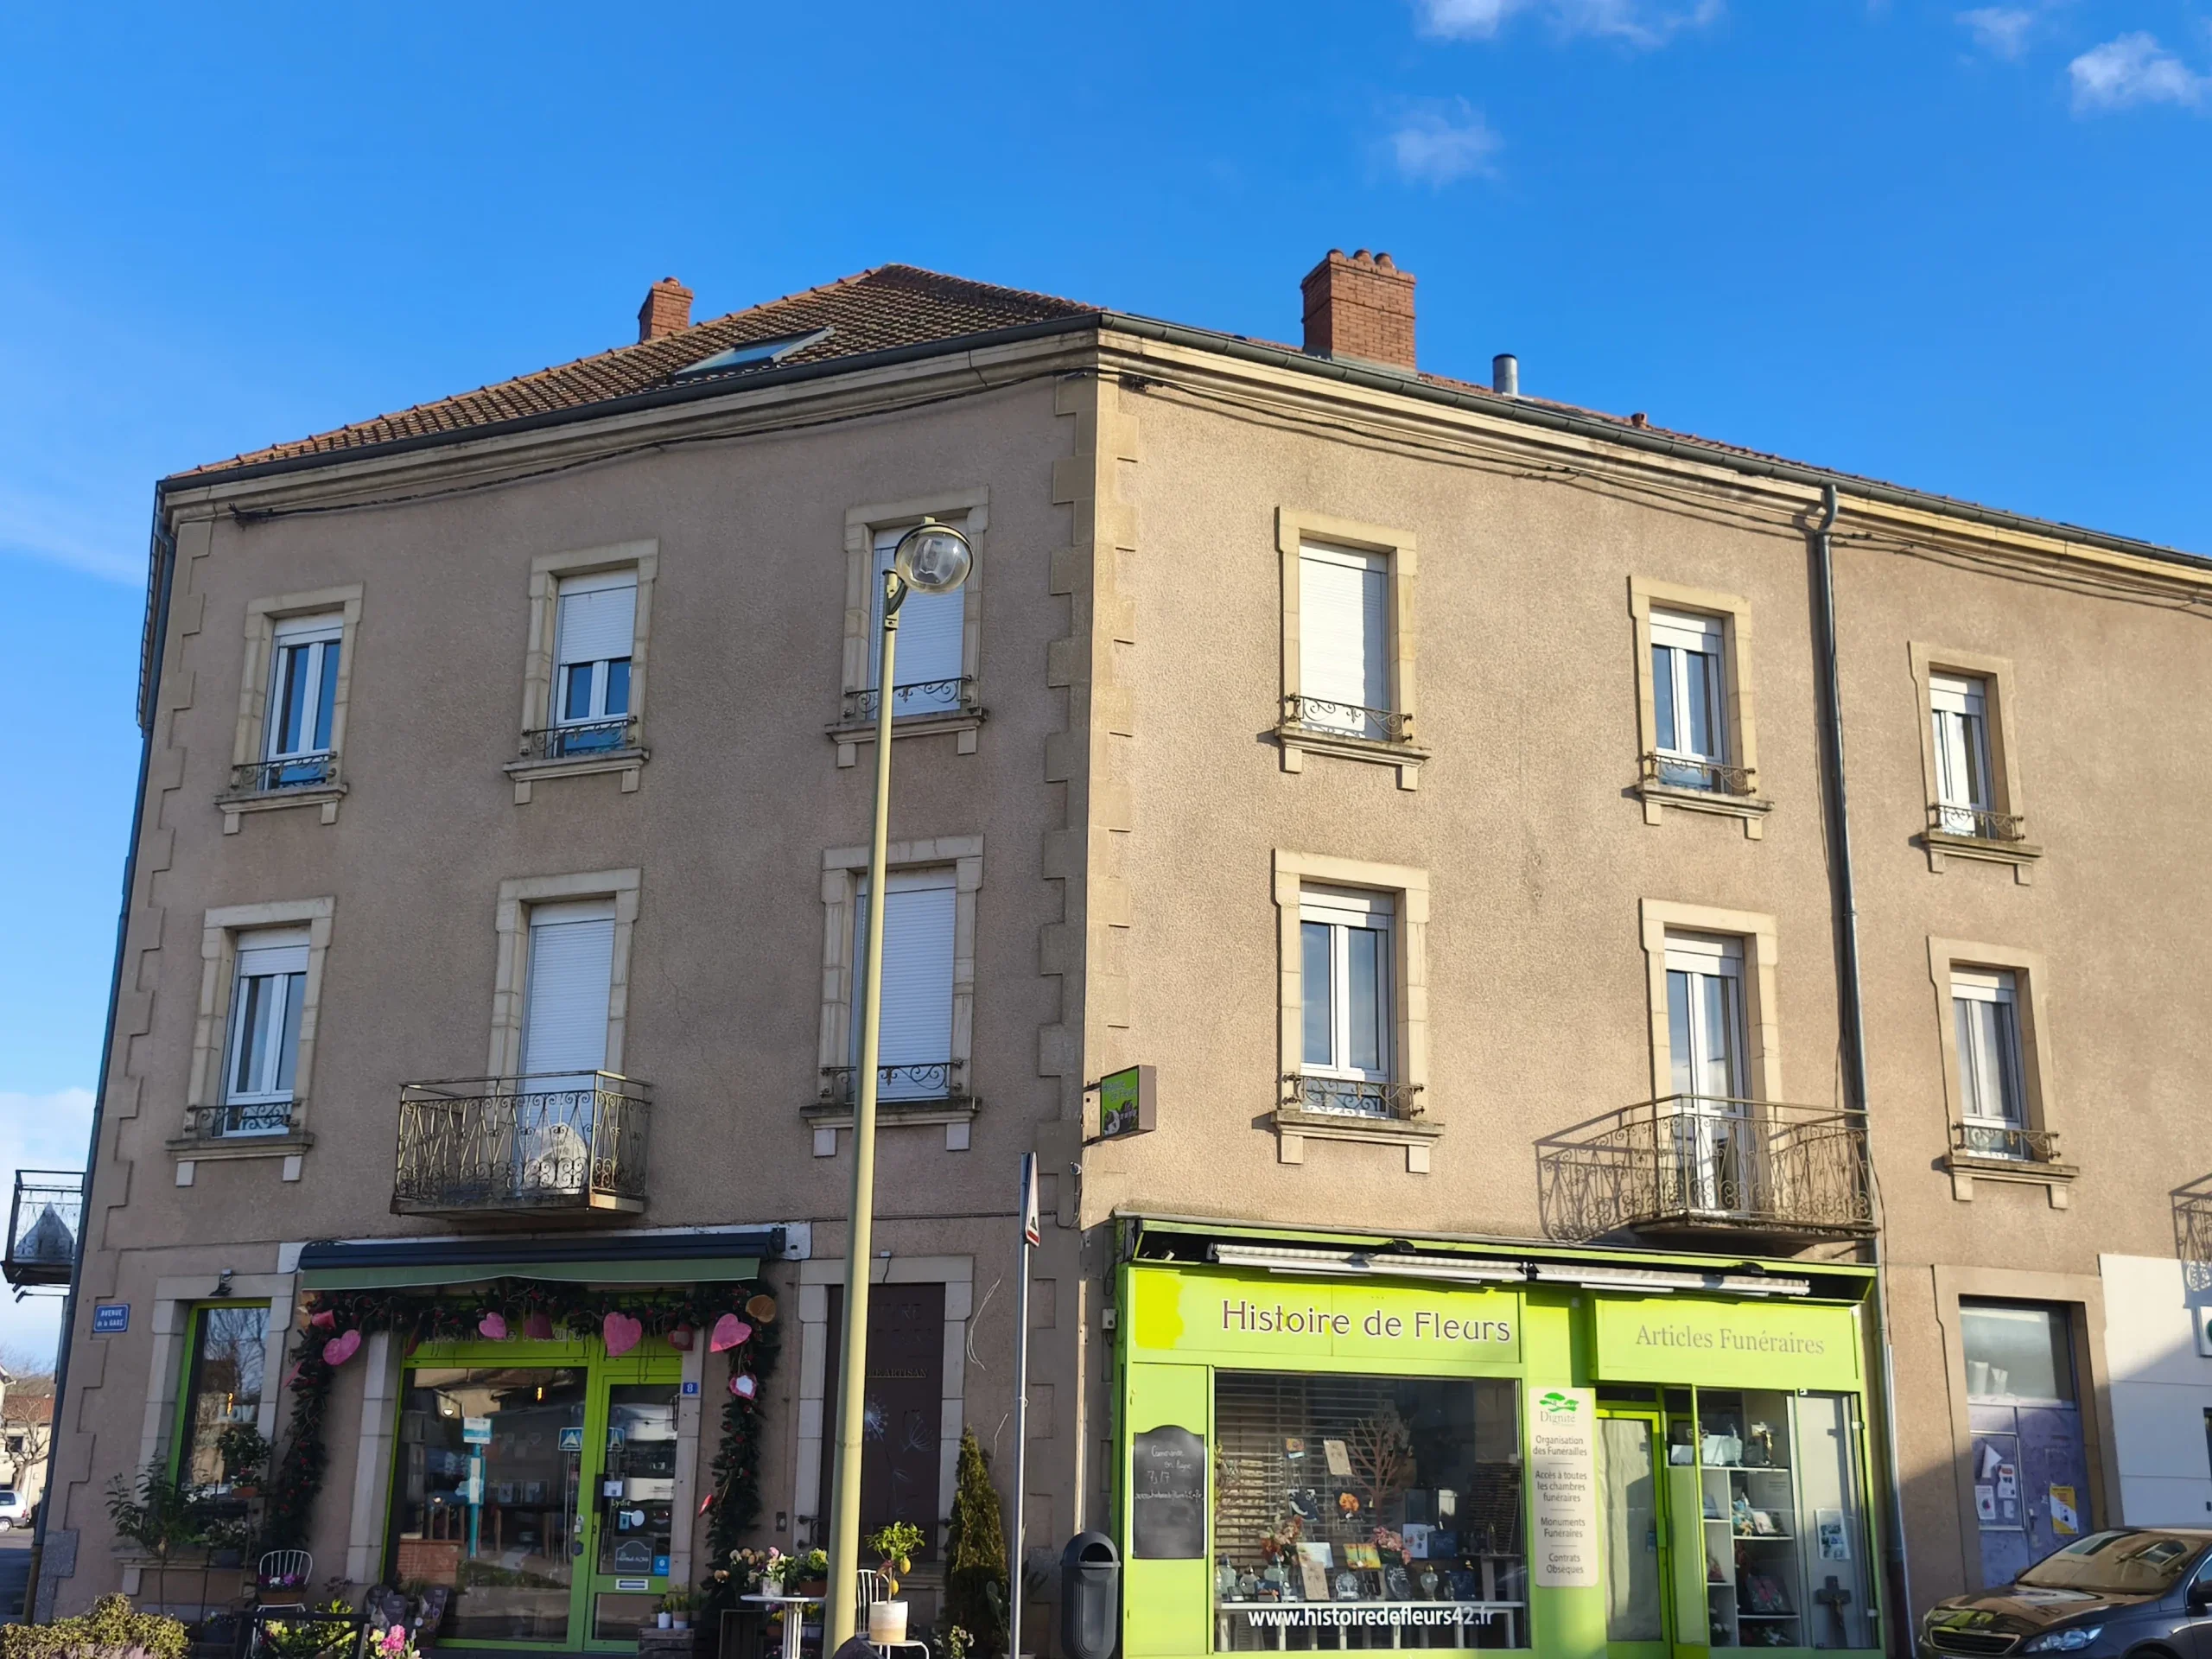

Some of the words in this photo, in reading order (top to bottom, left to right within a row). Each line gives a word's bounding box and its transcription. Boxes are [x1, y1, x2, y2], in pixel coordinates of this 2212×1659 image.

[1222, 1299, 1351, 1335] Histoire
[1363, 1309, 1402, 1337] de
[1414, 1311, 1511, 1341] Fleurs
[1635, 1324, 1713, 1349] Articles
[1719, 1327, 1825, 1355] Funéraires
[687, 1382, 694, 1393] 8
[1540, 1409, 1576, 1423] Dignité
[1535, 1434, 1584, 1446] Organisation
[1532, 1446, 1546, 1455] des
[1547, 1446, 1587, 1456] Funérailles
[1535, 1470, 1555, 1479] Accès
[1557, 1471, 1562, 1479] à
[1563, 1471, 1587, 1480] toutes
[1537, 1481, 1548, 1491] les
[1548, 1481, 1586, 1491] chambres
[1543, 1492, 1581, 1503] funéraires
[1540, 1516, 1586, 1527] Monuments
[1543, 1528, 1583, 1538] Funéraires
[1548, 1553, 1580, 1562] Contrats
[1546, 1564, 1584, 1575] Obsèques
[1248, 1606, 1494, 1626] www.histoiredefleurs42.fr
